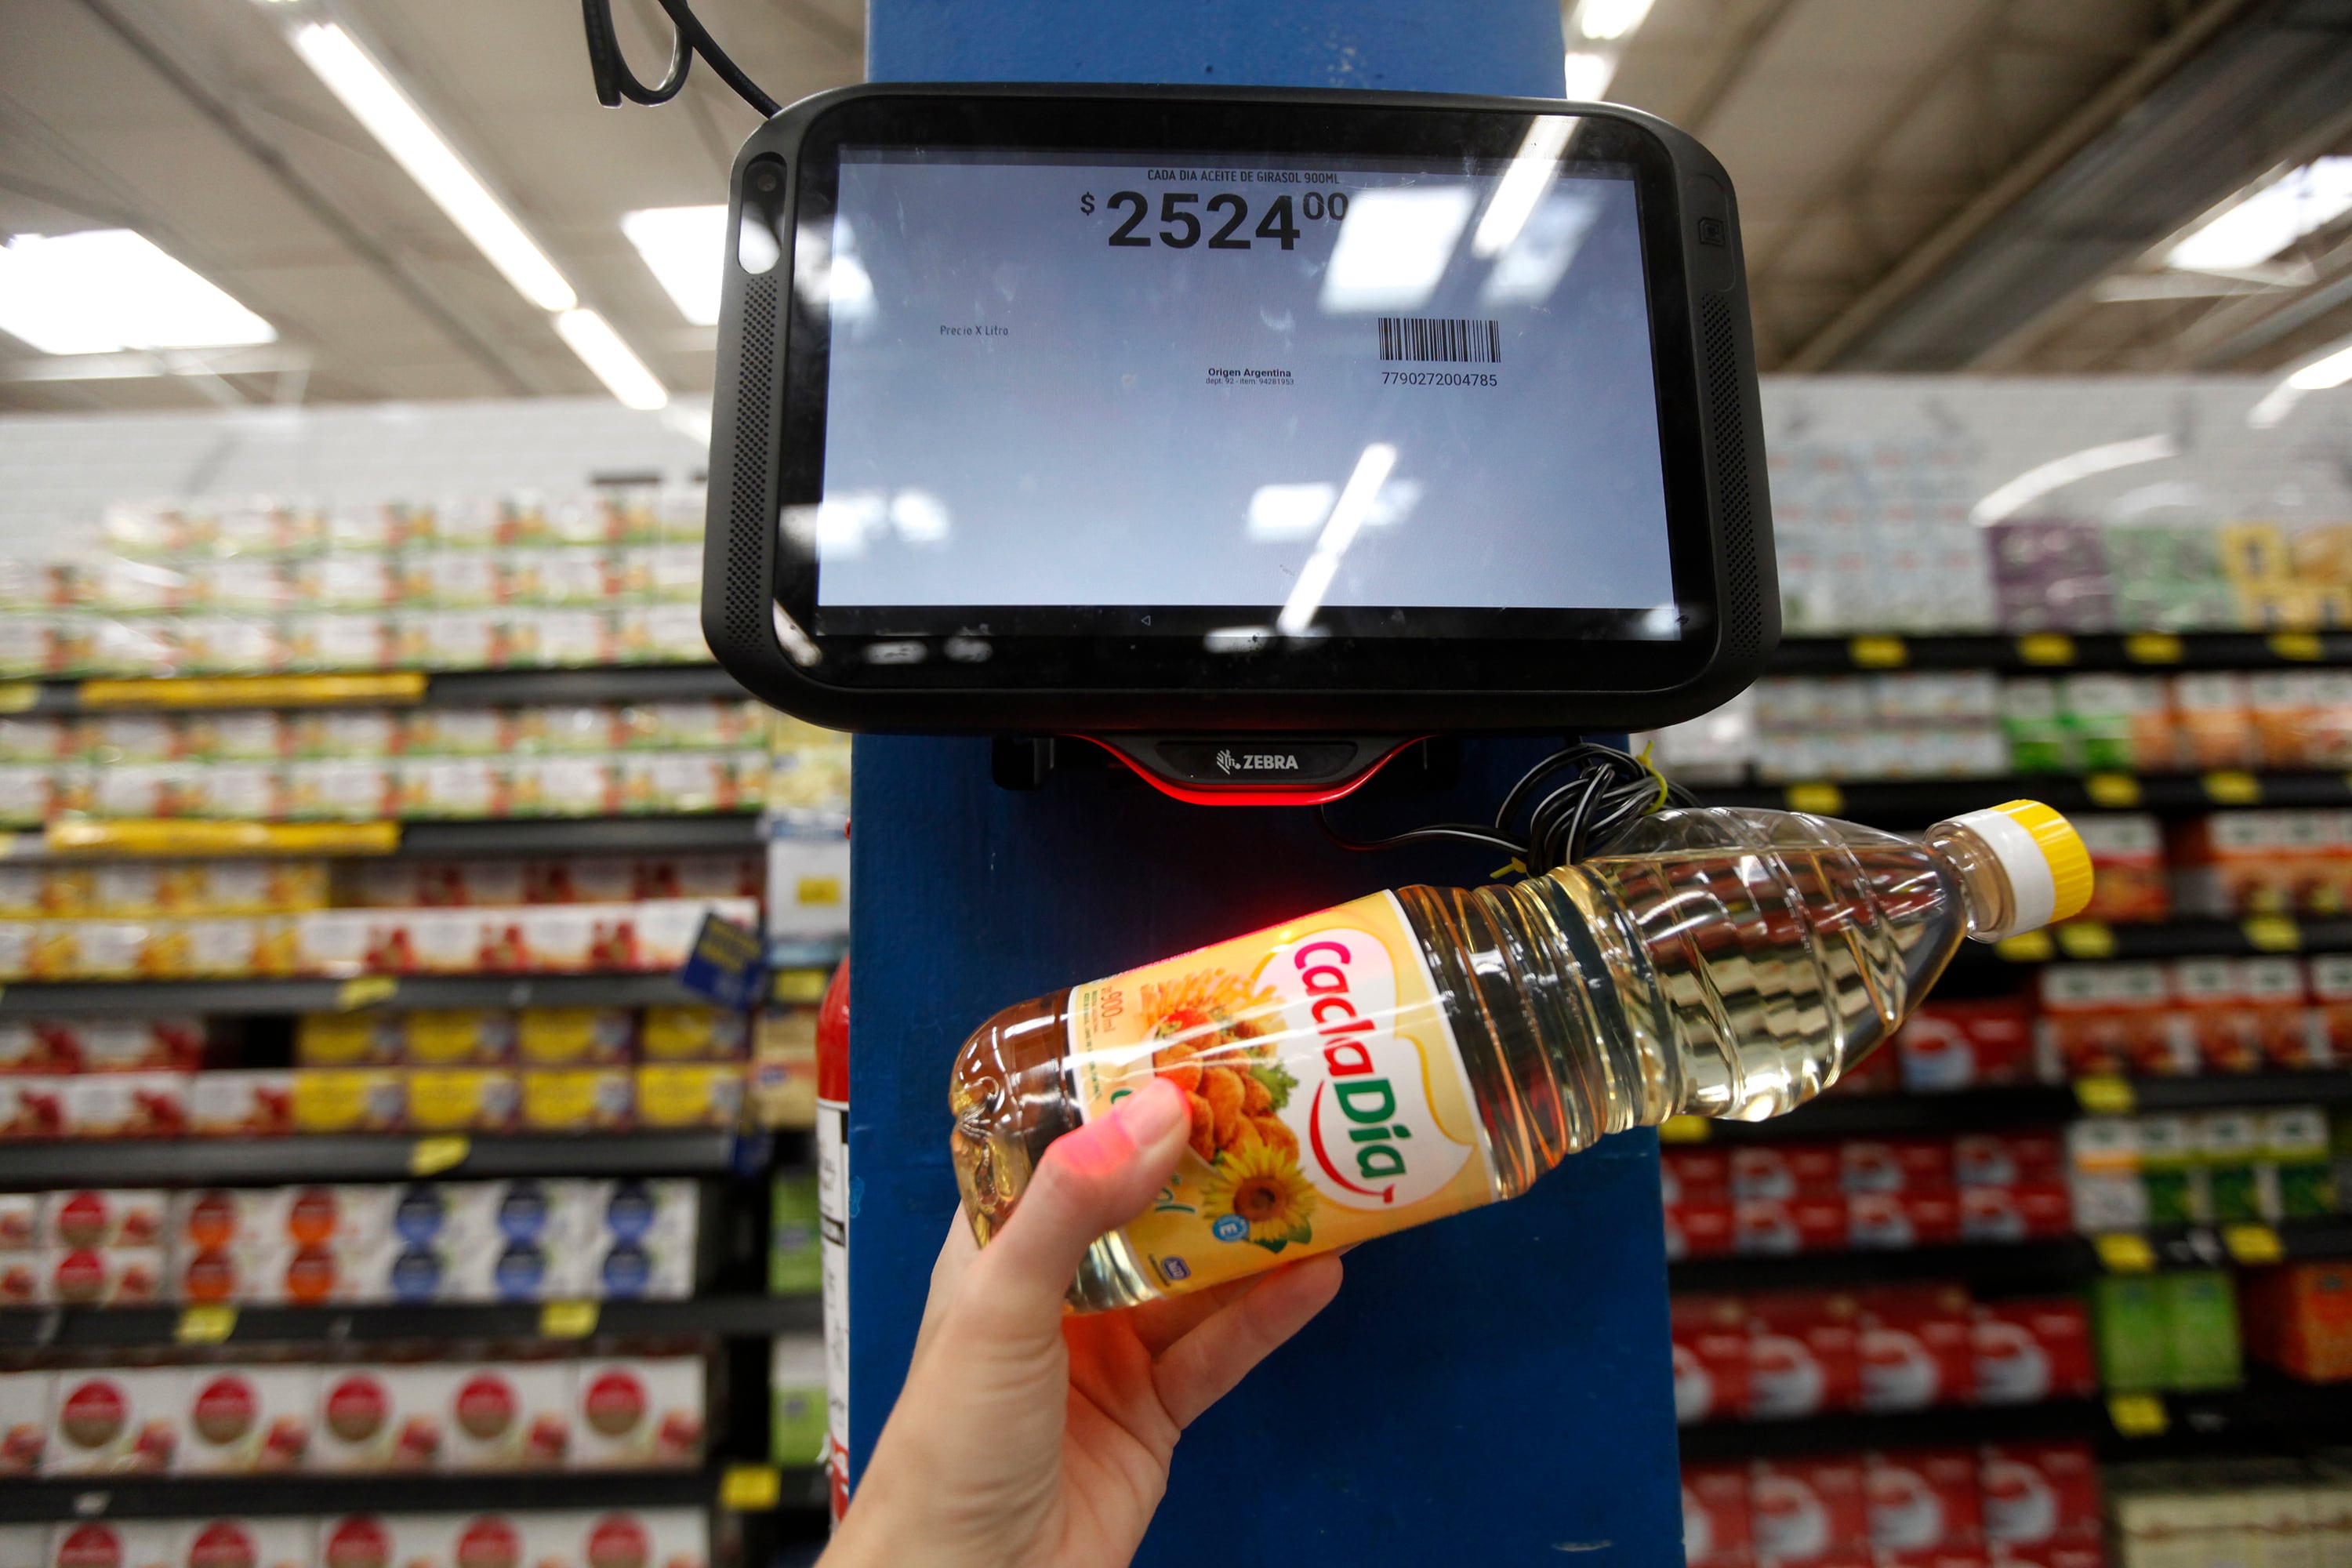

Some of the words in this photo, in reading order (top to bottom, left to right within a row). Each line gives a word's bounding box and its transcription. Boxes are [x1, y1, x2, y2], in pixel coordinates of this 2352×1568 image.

[1147, 169, 1176, 181] CADA
[1179, 170, 1198, 181] DIA
[1200, 170, 1237, 182] ACEITE
[1240, 171, 1254, 182] DE
[1257, 171, 1302, 183] GIRASOL
[1304, 172, 1341, 184] 900ML
[940, 325, 972, 336] Precio
[975, 325, 982, 336] X
[985, 325, 1009, 336] Litro
[1208, 368, 1241, 377] Origen
[1243, 368, 1291, 378] Argentina
[1381, 372, 1498, 387] 7790272004785
[1243, 754, 1299, 770] ZEBRA
